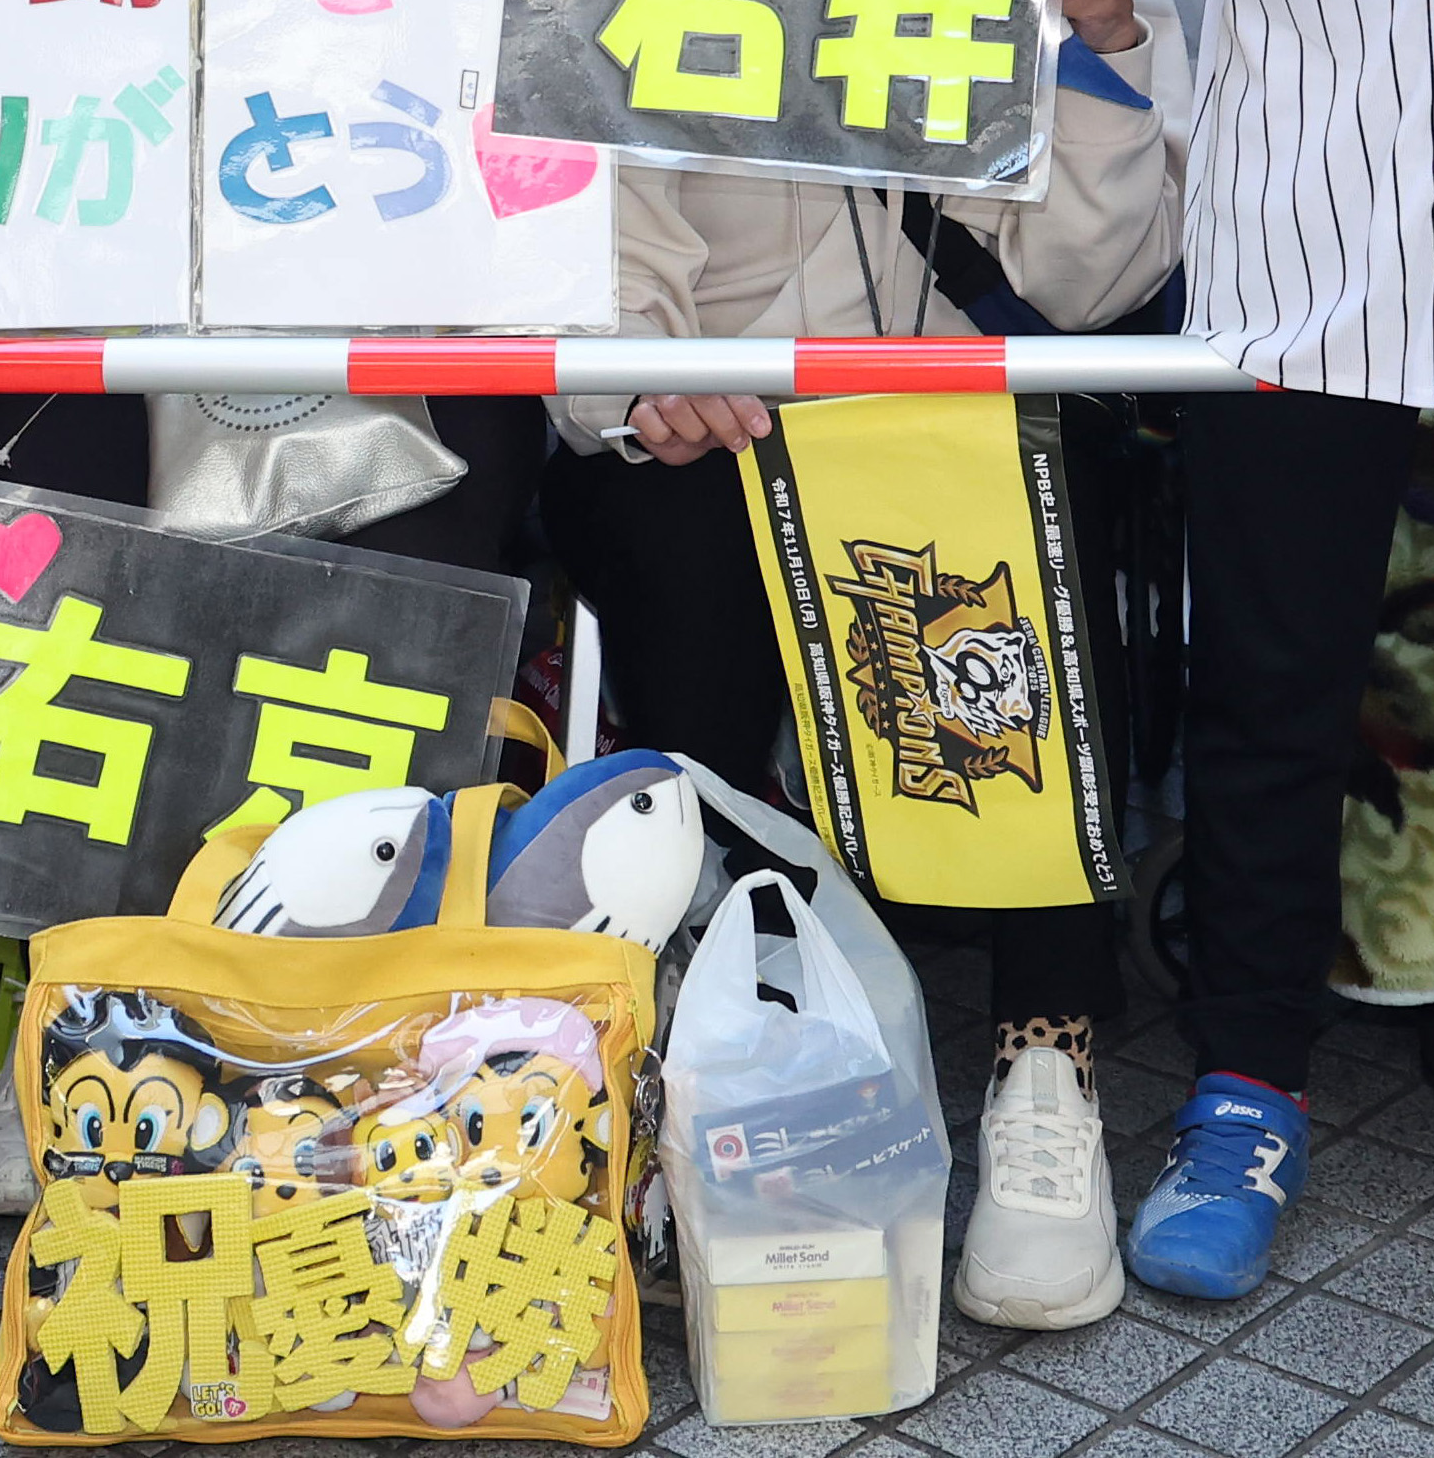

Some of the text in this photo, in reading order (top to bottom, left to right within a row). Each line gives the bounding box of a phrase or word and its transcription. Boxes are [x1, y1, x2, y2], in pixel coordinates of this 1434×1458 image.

[827, 541, 978, 814] CHAMPIONS
[1032, 644, 1052, 696] CENTRAL
[1035, 696, 1052, 740] LEAGUE
[1230, 1104, 1263, 1119] asics
[765, 1250, 830, 1265] Millet Sand
[191, 1382, 237, 1403] LET'S
[194, 1403, 223, 1417] GO!
